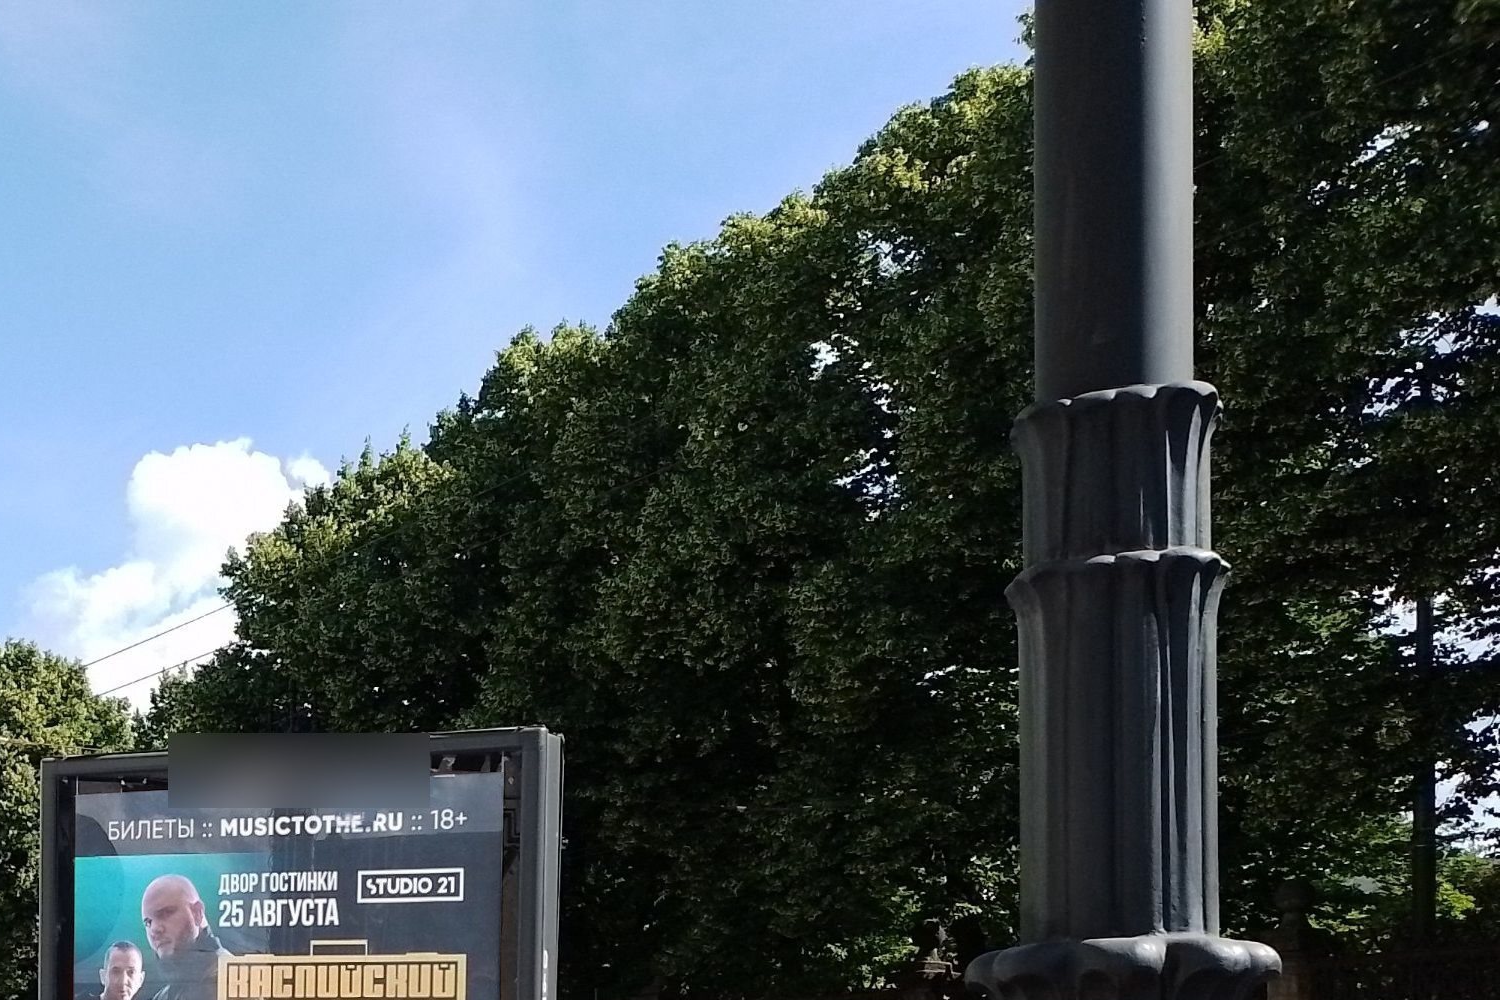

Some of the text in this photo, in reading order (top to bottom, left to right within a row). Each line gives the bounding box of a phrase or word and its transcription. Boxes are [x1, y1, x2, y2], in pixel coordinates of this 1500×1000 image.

[107, 818, 195, 841] БИЛЕТЫ
[220, 811, 403, 837] MUSICTOTHE.RU
[430, 808, 468, 830] 18+
[218, 870, 339, 895] ДВОР ГОСТИНКИ
[366, 876, 455, 896] STUDIO 21
[218, 898, 340, 928] 25 АВГУСТА
[227, 963, 457, 999] КАСПИЙСКИЙ
